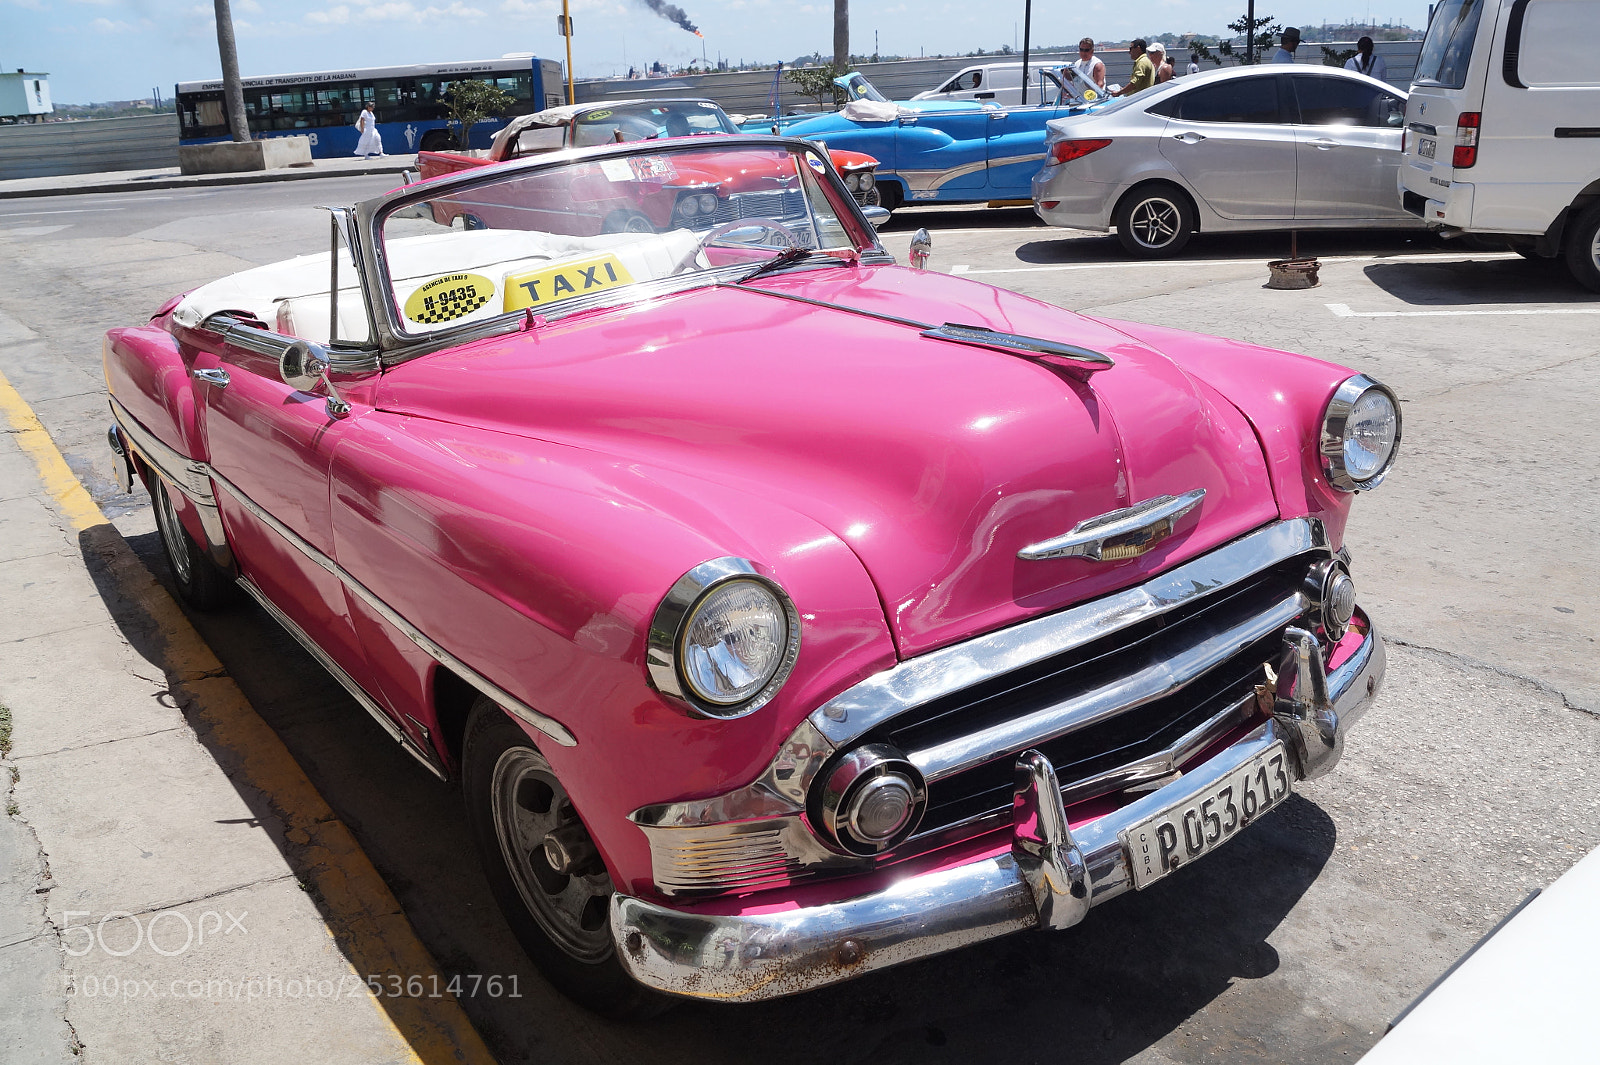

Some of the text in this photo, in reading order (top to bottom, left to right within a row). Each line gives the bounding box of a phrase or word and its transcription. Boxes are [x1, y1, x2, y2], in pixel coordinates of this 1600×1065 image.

[202, 82, 224, 90] EMPRES
[242, 79, 264, 87] VINCIAL
[275, 76, 313, 84] TRANSPORTE
[422, 278, 444, 292] AGENCIA
[519, 262, 618, 301] TAXI
[423, 284, 477, 311] H-9435
[1139, 833, 1152, 876] CUBA
